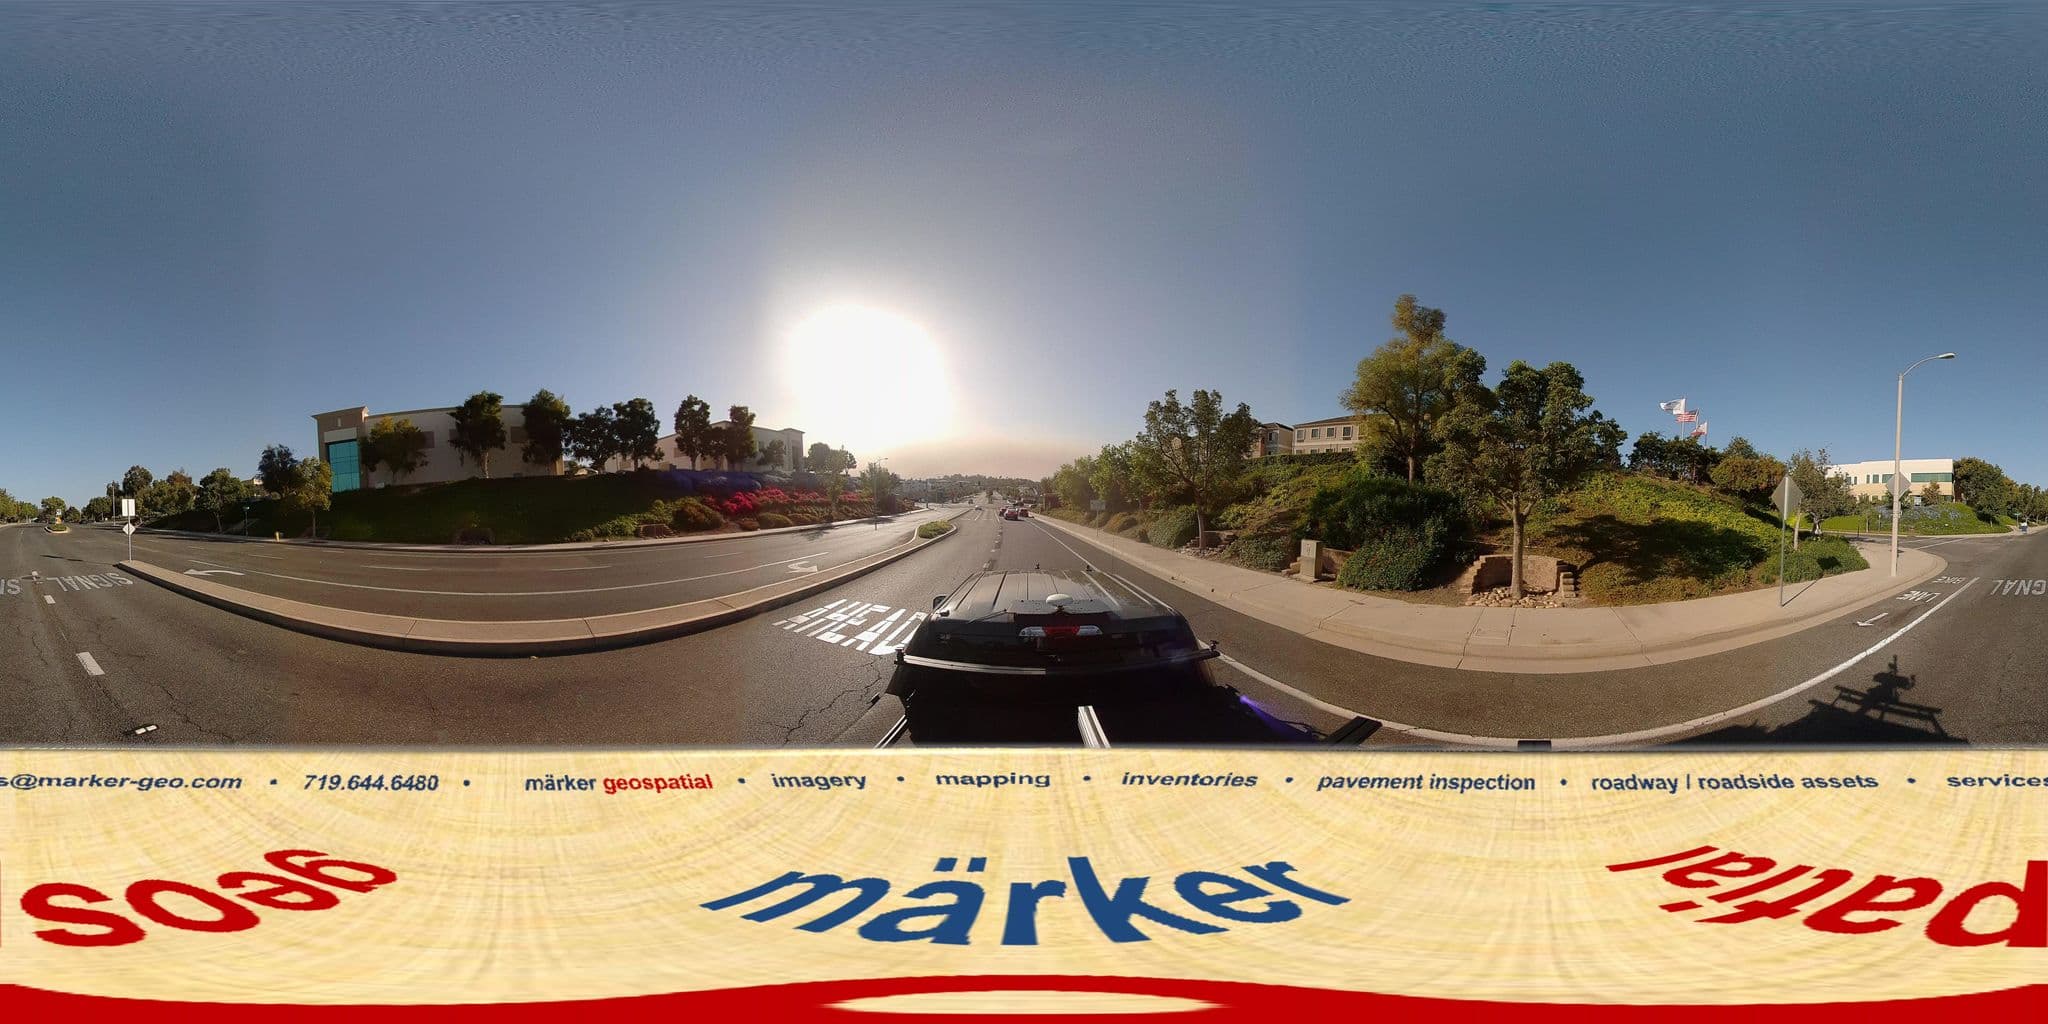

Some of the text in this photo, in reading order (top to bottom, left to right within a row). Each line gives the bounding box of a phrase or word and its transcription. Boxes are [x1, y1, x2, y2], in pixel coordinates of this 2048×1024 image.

[46, 572, 133, 592] SIGNAL
[1895, 590, 1941, 603] LANE
[772, 598, 929, 656] AHEAD
